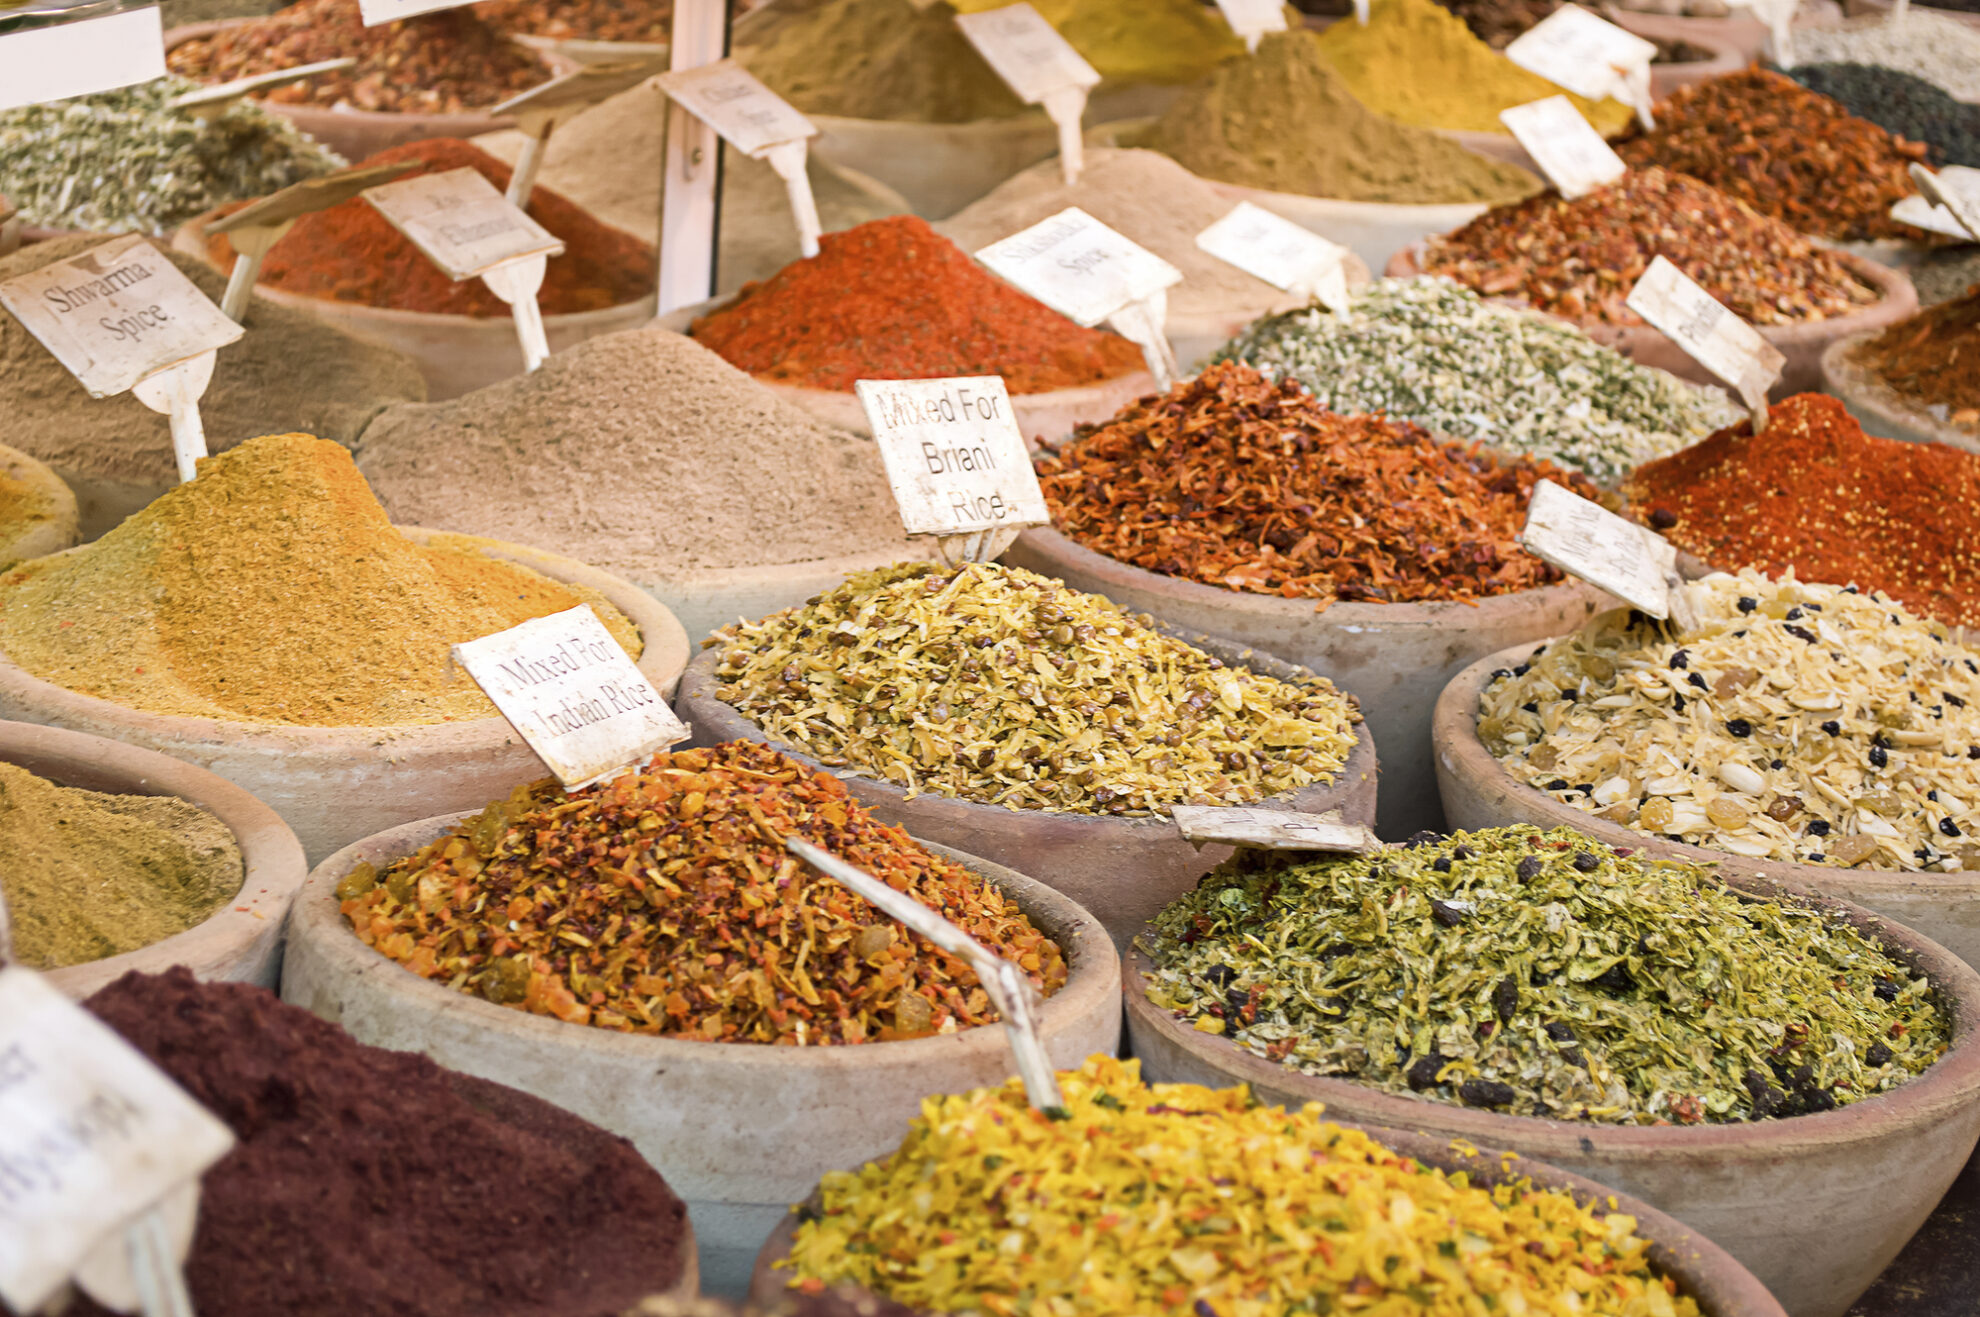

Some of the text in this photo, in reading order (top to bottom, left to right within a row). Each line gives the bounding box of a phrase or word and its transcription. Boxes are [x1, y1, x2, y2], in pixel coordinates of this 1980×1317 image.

[44, 262, 151, 313] Shwarma
[99, 303, 169, 343] Spice
[876, 388, 1001, 430] Mixed For
[921, 437, 996, 475] Briani
[947, 488, 1006, 523] Rice
[496, 637, 615, 691] Mixed For
[531, 681, 654, 739] Indian Rice
